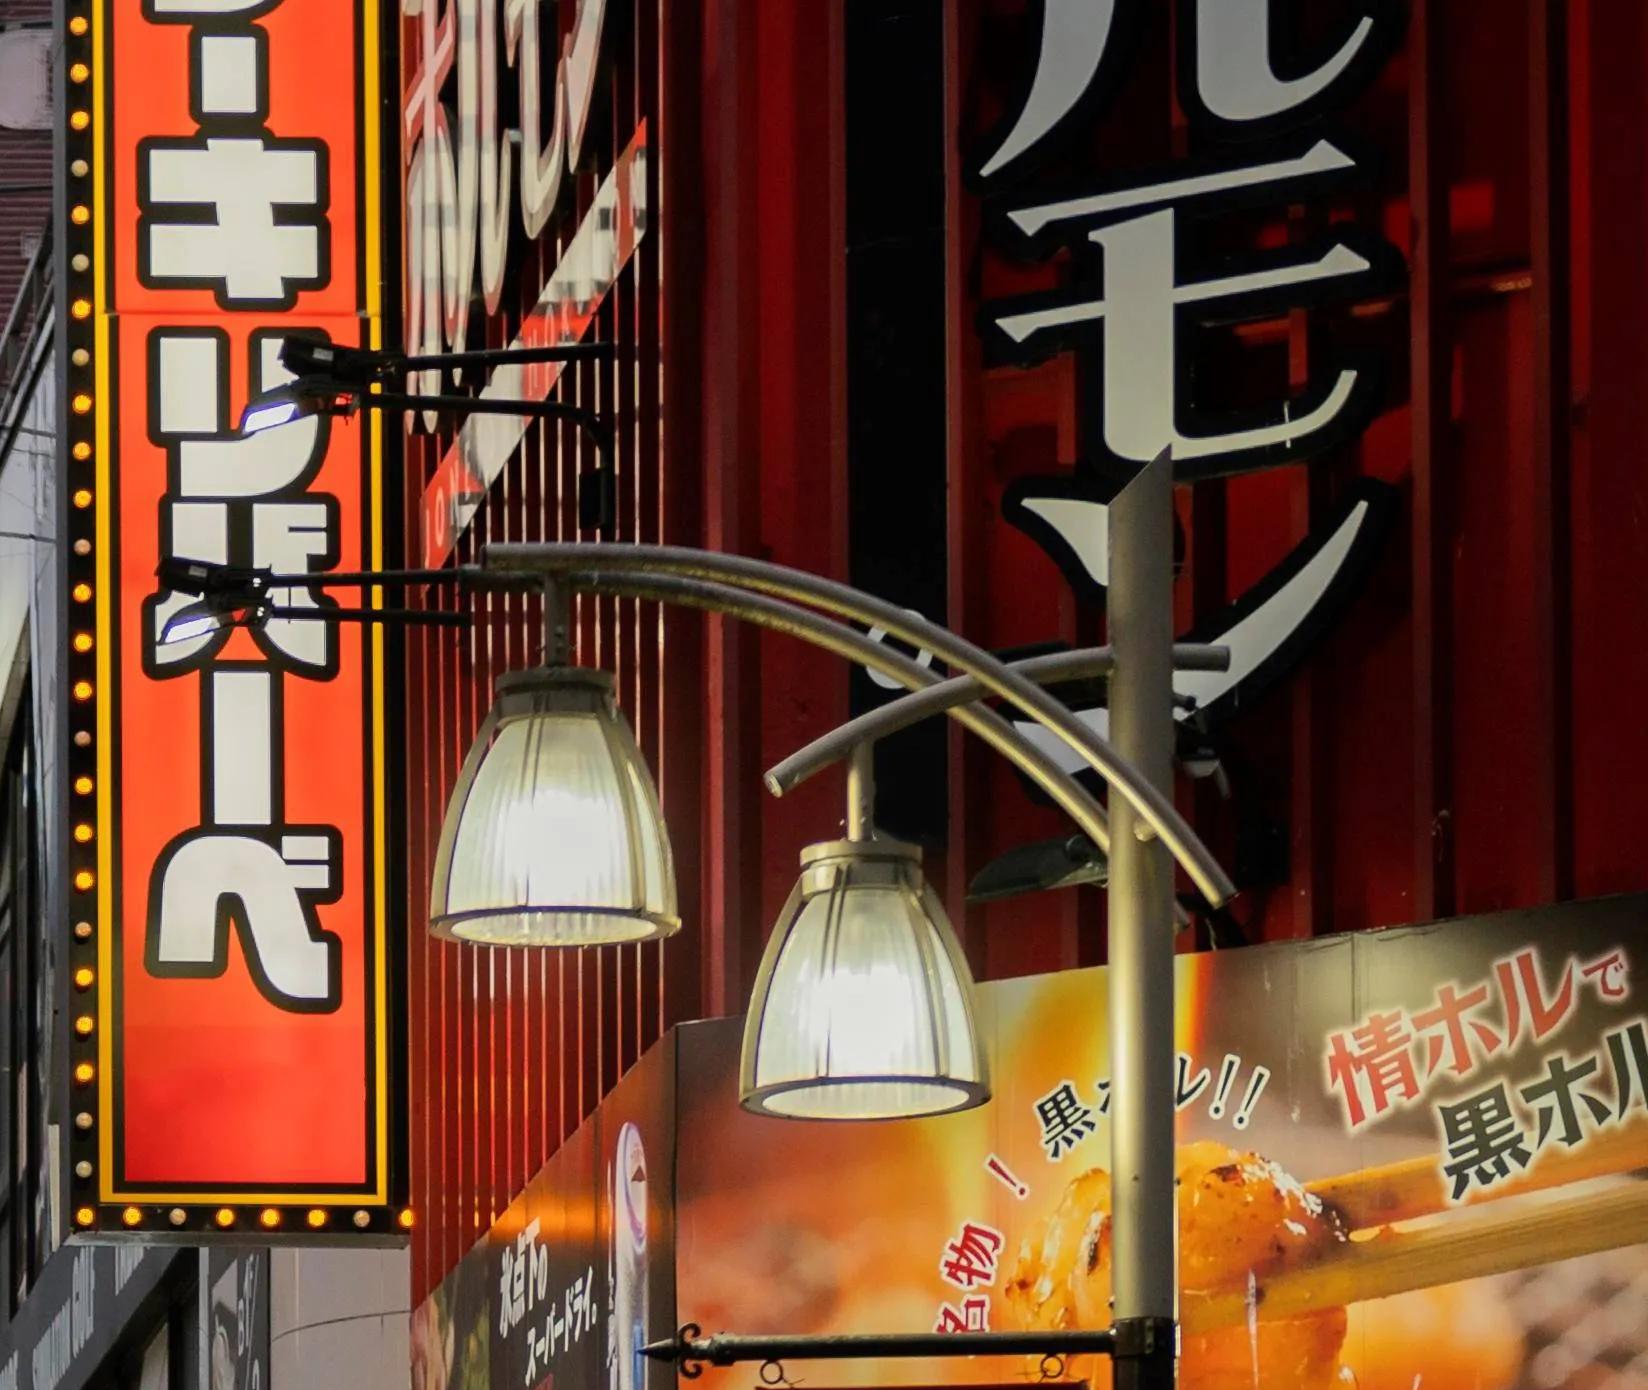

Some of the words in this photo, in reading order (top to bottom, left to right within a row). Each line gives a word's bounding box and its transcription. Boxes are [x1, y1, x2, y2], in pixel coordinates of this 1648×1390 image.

[142, 0, 341, 1006] ーキリバーベ
[500, 1216, 548, 1339] 氷点下の
